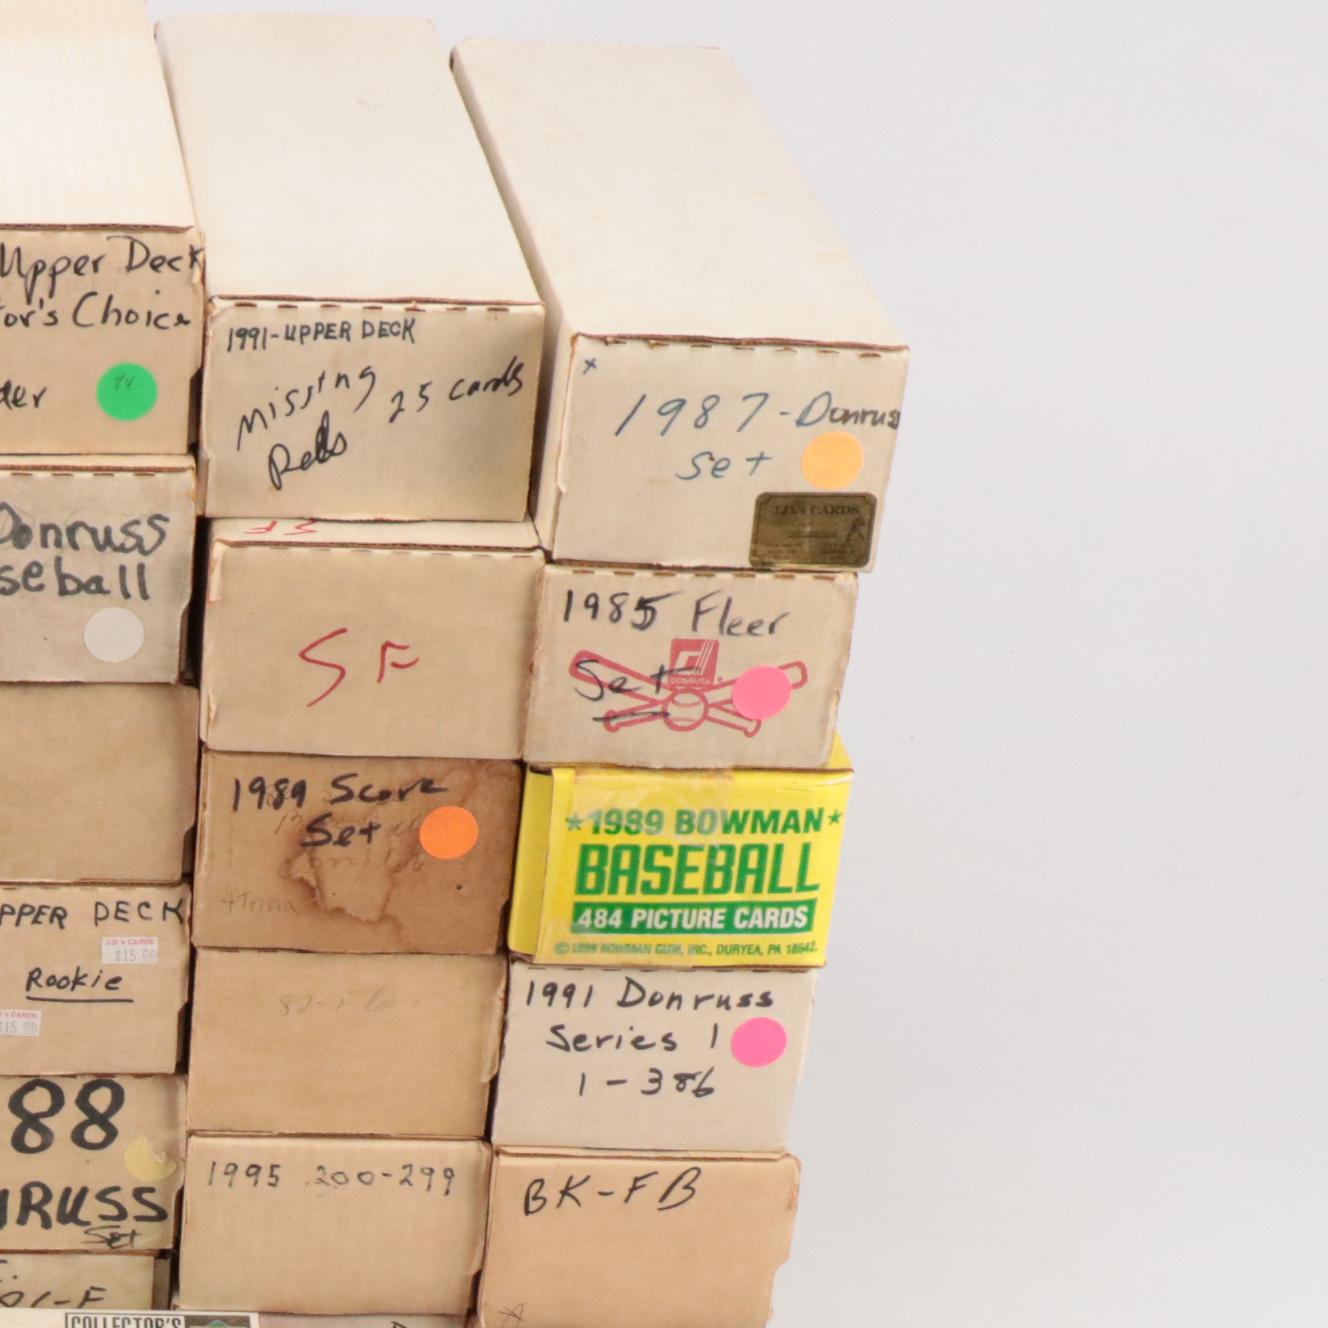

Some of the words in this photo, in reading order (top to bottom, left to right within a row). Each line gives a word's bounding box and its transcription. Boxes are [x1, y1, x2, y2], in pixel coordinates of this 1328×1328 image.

[0, 244, 105, 303] Upper
[106, 235, 203, 277] Deck
[72, 292, 192, 329] Choice
[360, 320, 415, 342] DECK
[389, 382, 432, 423] 25
[691, 590, 790, 636] Fleer
[231, 776, 307, 811] 1989
[330, 774, 448, 801] Score
[301, 813, 380, 848] Set
[590, 809, 664, 835] 1989
[675, 808, 825, 835] BOWMAN
[574, 842, 821, 896] BASEBALL
[94, 900, 185, 926] DECK
[577, 908, 623, 928] 484
[631, 907, 725, 929] PICTURE
[733, 906, 808, 928] CARDS
[716, 944, 763, 956] DURYEA,
[26, 966, 122, 991] Rookie
[526, 981, 594, 1009] 1991
[617, 977, 774, 1011] Donruss
[546, 1024, 678, 1053] Series
[206, 1162, 281, 1189] 1995
